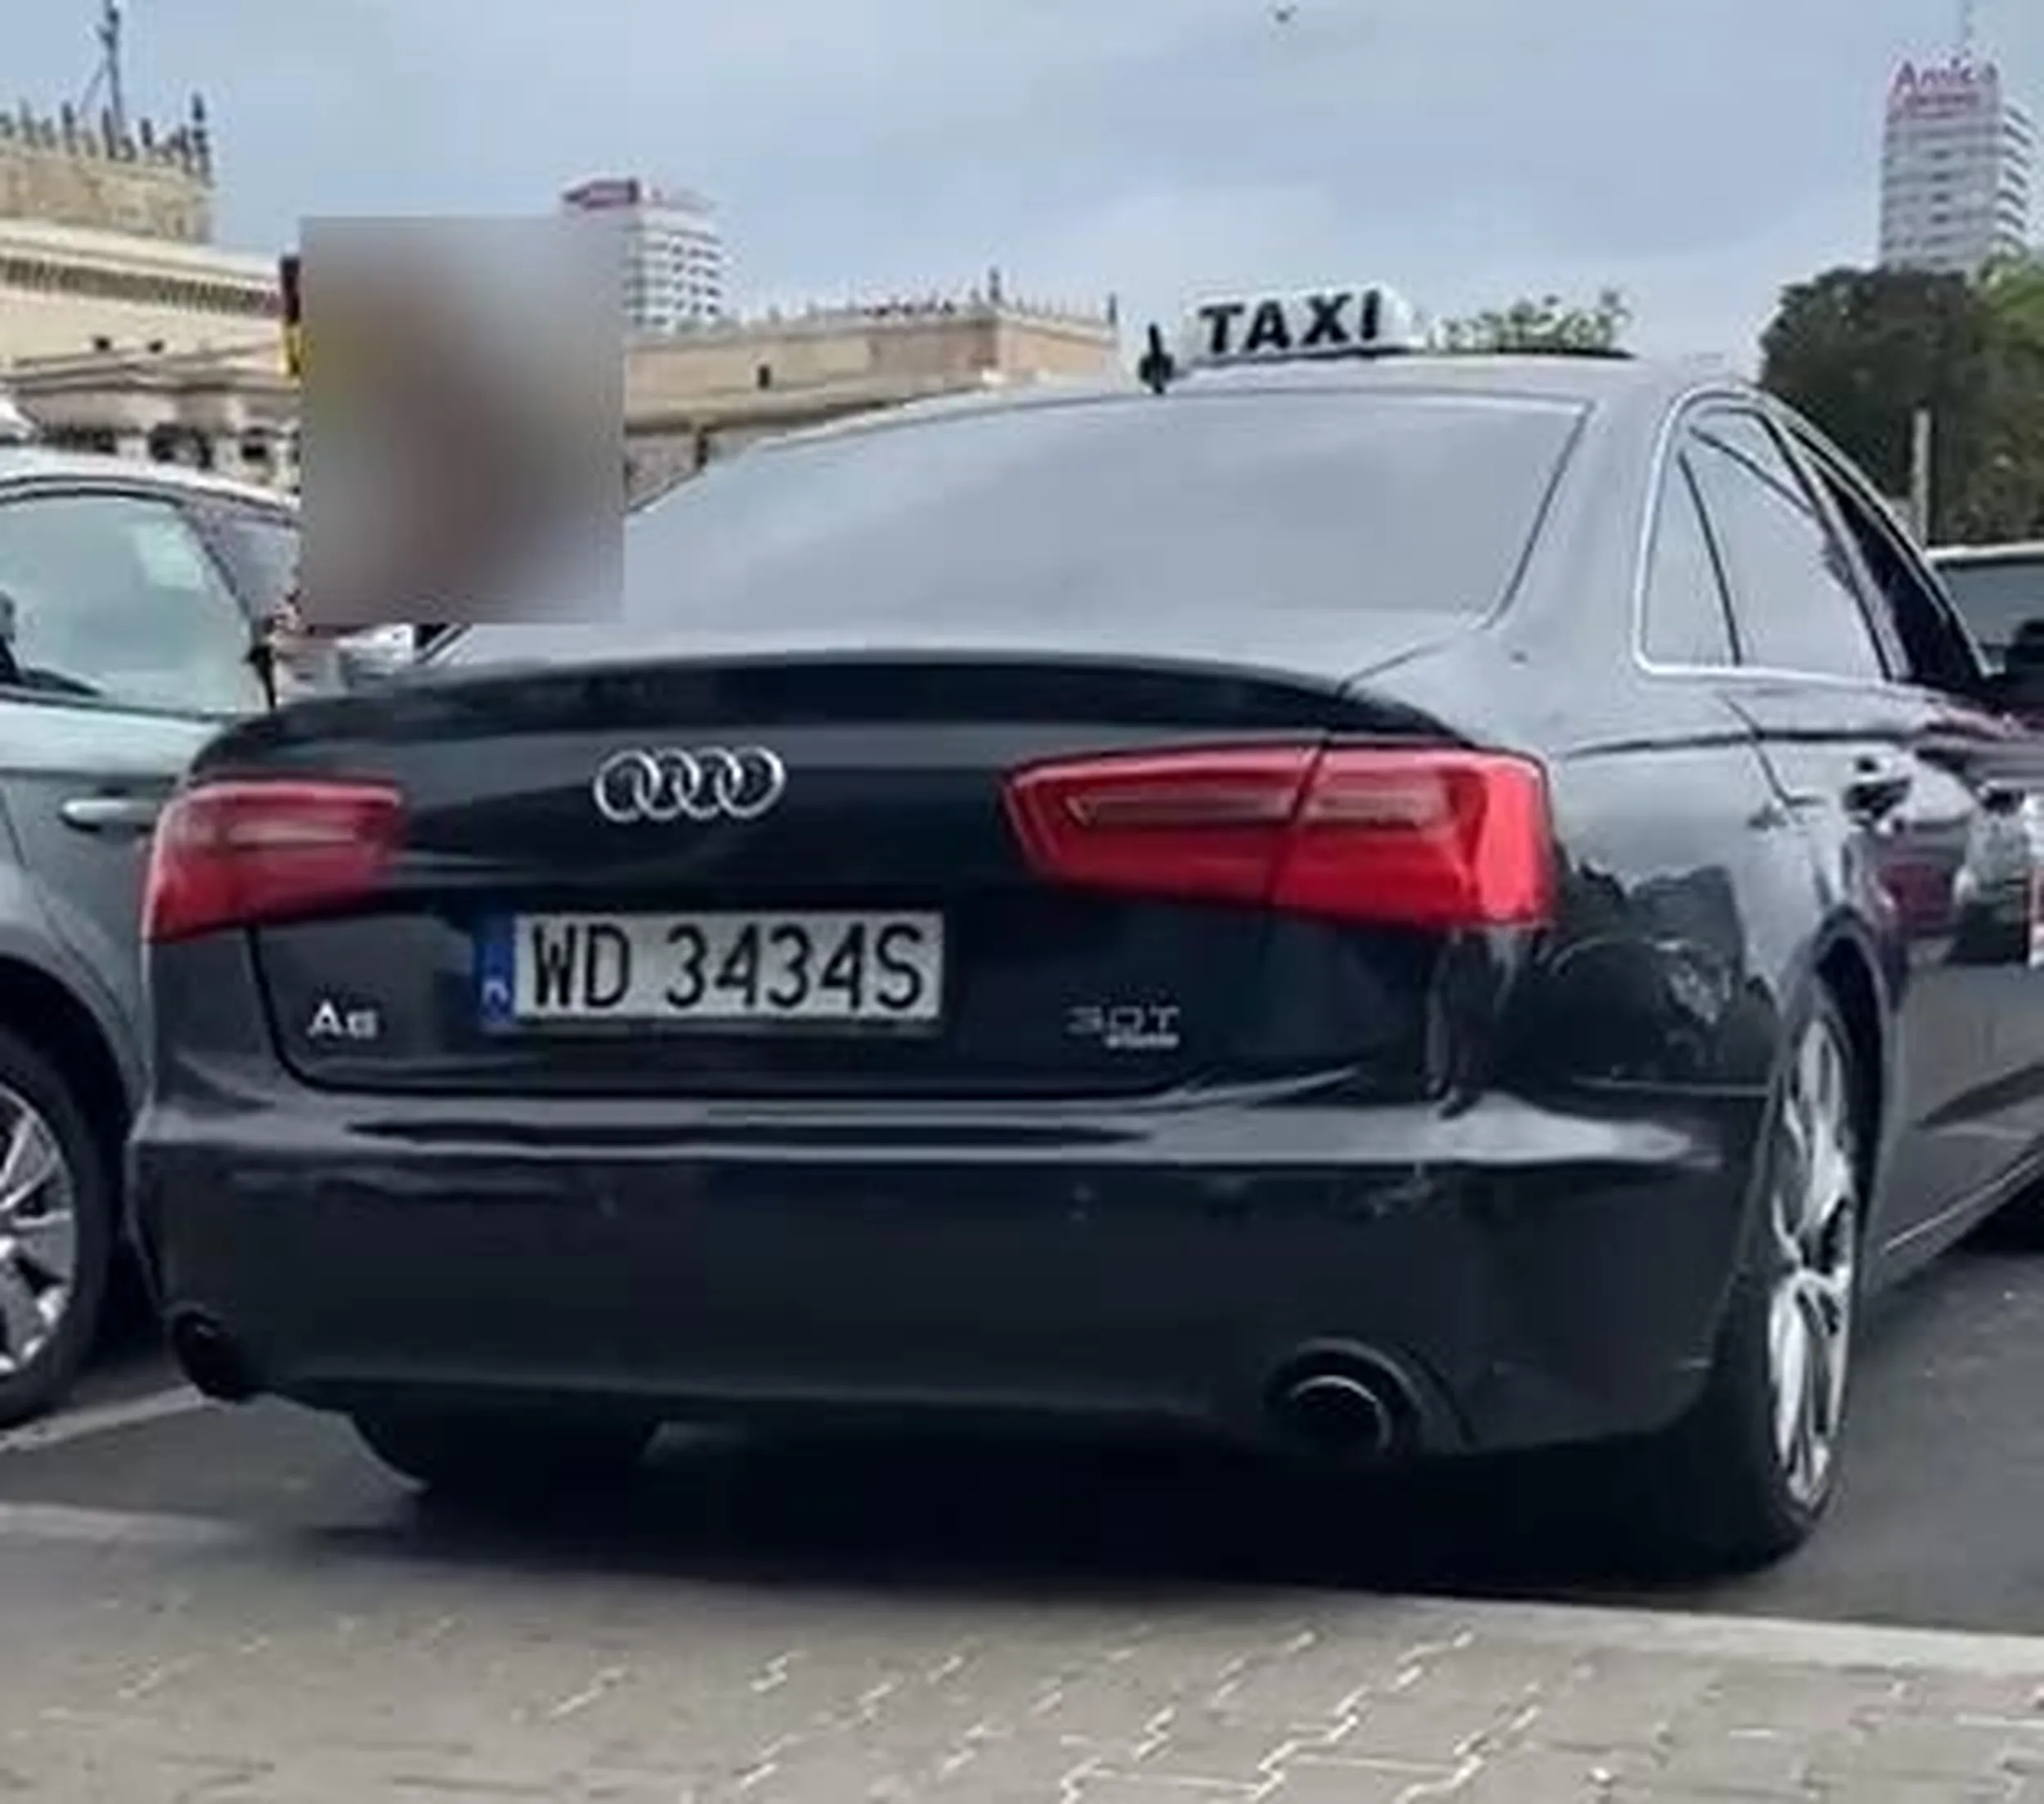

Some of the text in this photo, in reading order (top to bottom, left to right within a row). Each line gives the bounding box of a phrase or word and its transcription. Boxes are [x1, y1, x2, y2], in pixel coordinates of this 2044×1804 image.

[1197, 289, 1382, 353] TAXI
[531, 922, 923, 1010] WD 3434S
